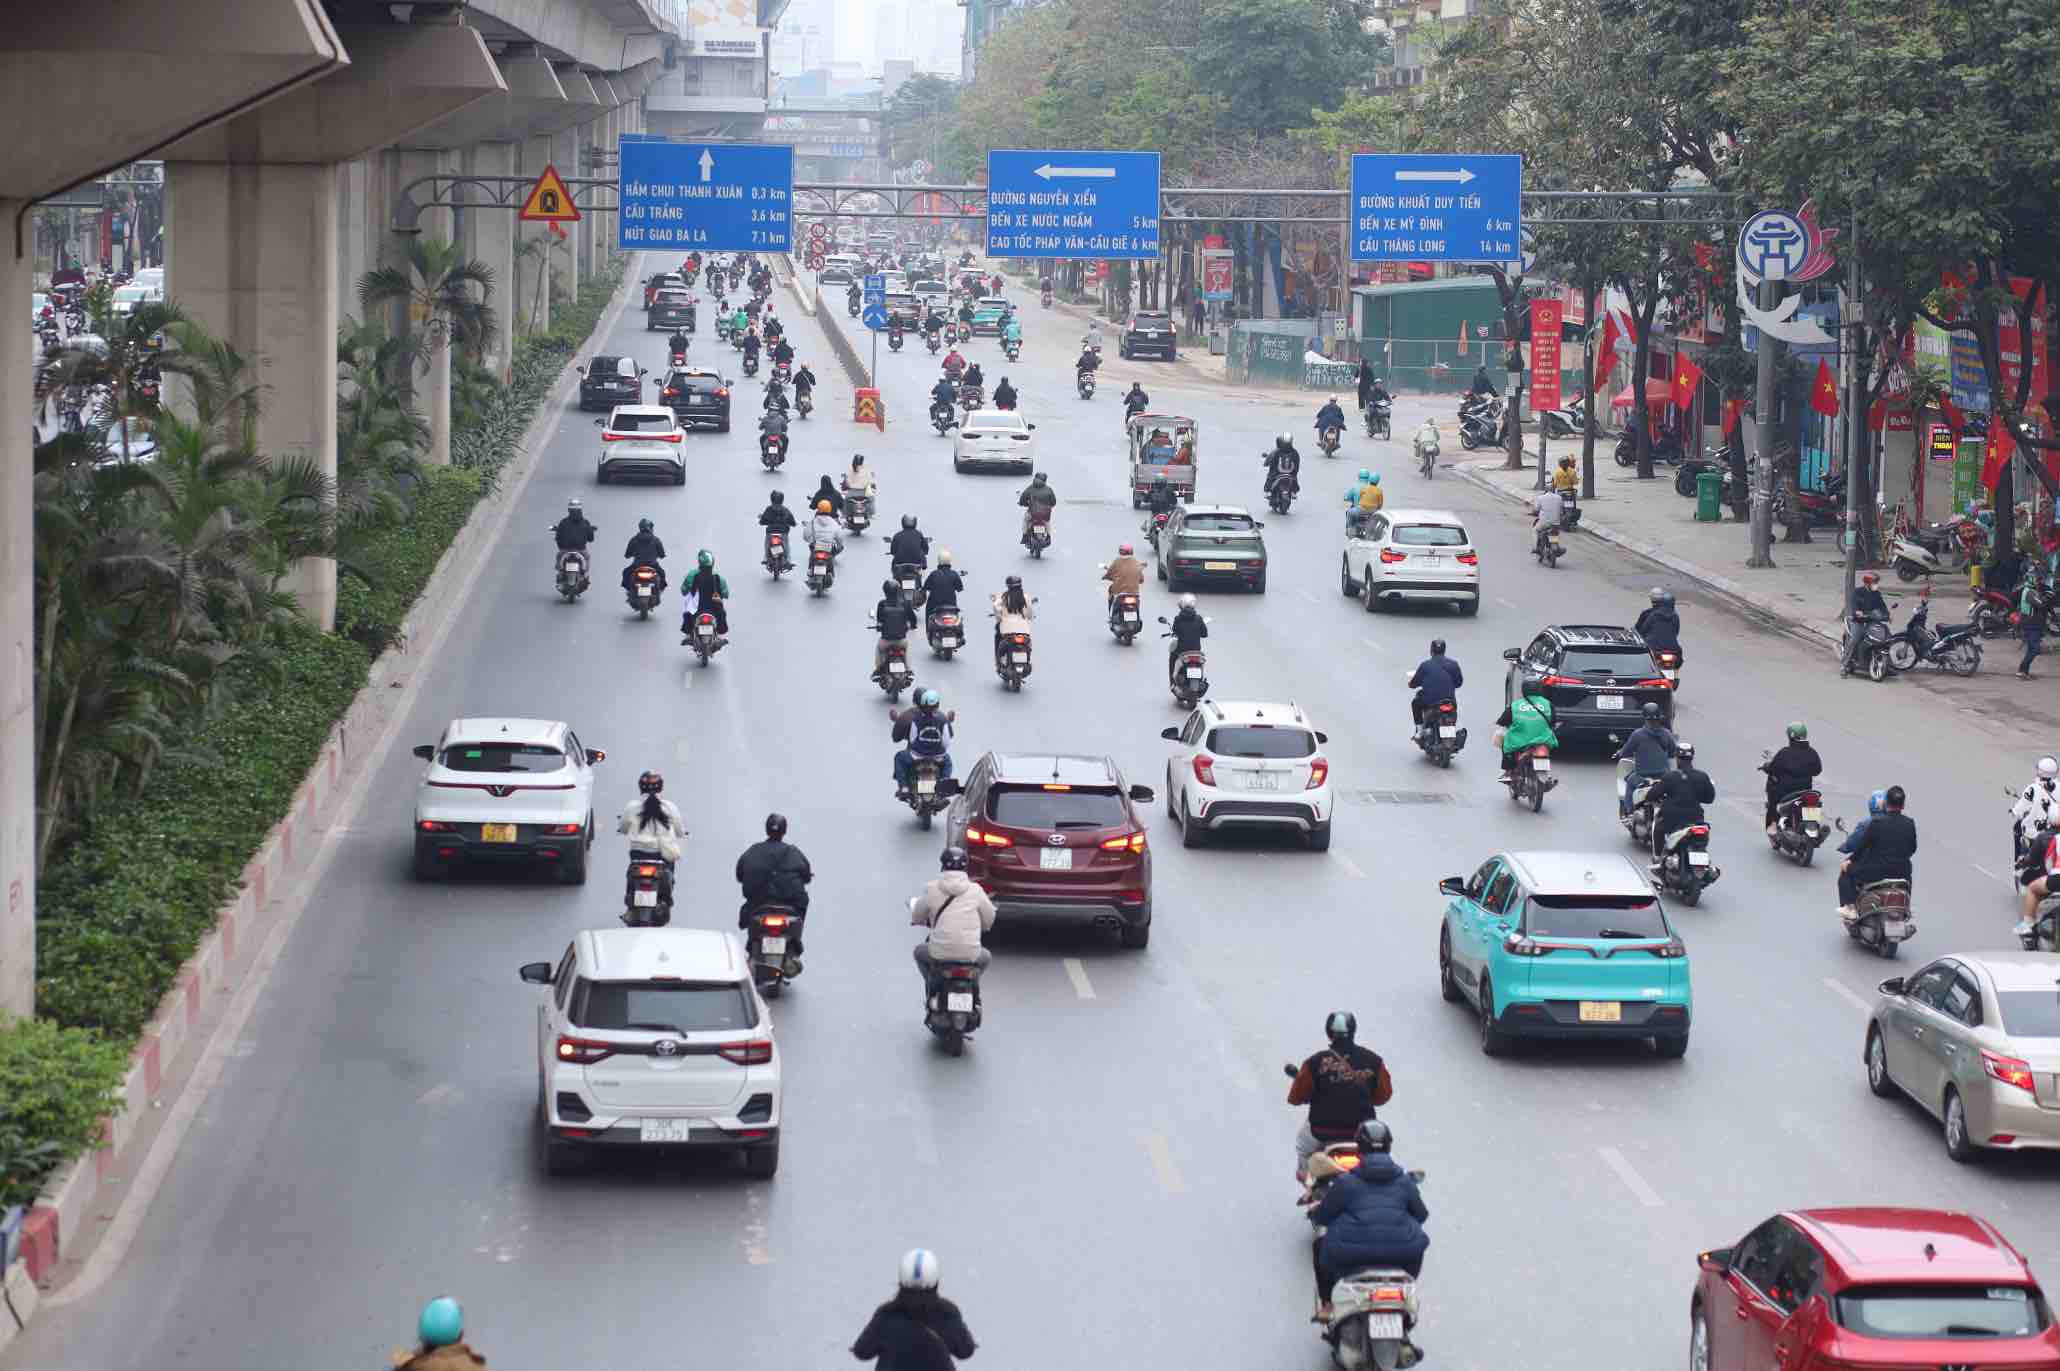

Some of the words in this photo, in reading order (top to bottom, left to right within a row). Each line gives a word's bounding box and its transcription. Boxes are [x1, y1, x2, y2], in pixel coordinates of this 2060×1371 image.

[651, 184, 674, 198] CHUI
[679, 185, 712, 198] THANH
[716, 182, 743, 199] XUÂN
[770, 187, 786, 200] km
[1434, 196, 1454, 209] DUY
[770, 210, 785, 222] km
[1015, 215, 1028, 227] XE
[1133, 216, 1140, 228] 5
[1143, 216, 1158, 229] km
[1384, 218, 1397, 230] XE
[1486, 219, 1492, 230] 6
[1496, 218, 1511, 230] km
[649, 228, 673, 241] GIAO
[676, 229, 689, 241] BA
[694, 229, 707, 242] LA
[769, 231, 785, 244] km
[991, 235, 1010, 248] CAO
[1131, 238, 1138, 250] 6
[1143, 239, 1158, 250] km
[1419, 240, 1445, 252] LONG
[1480, 240, 1492, 253] 14
[1496, 240, 1511, 253] km
